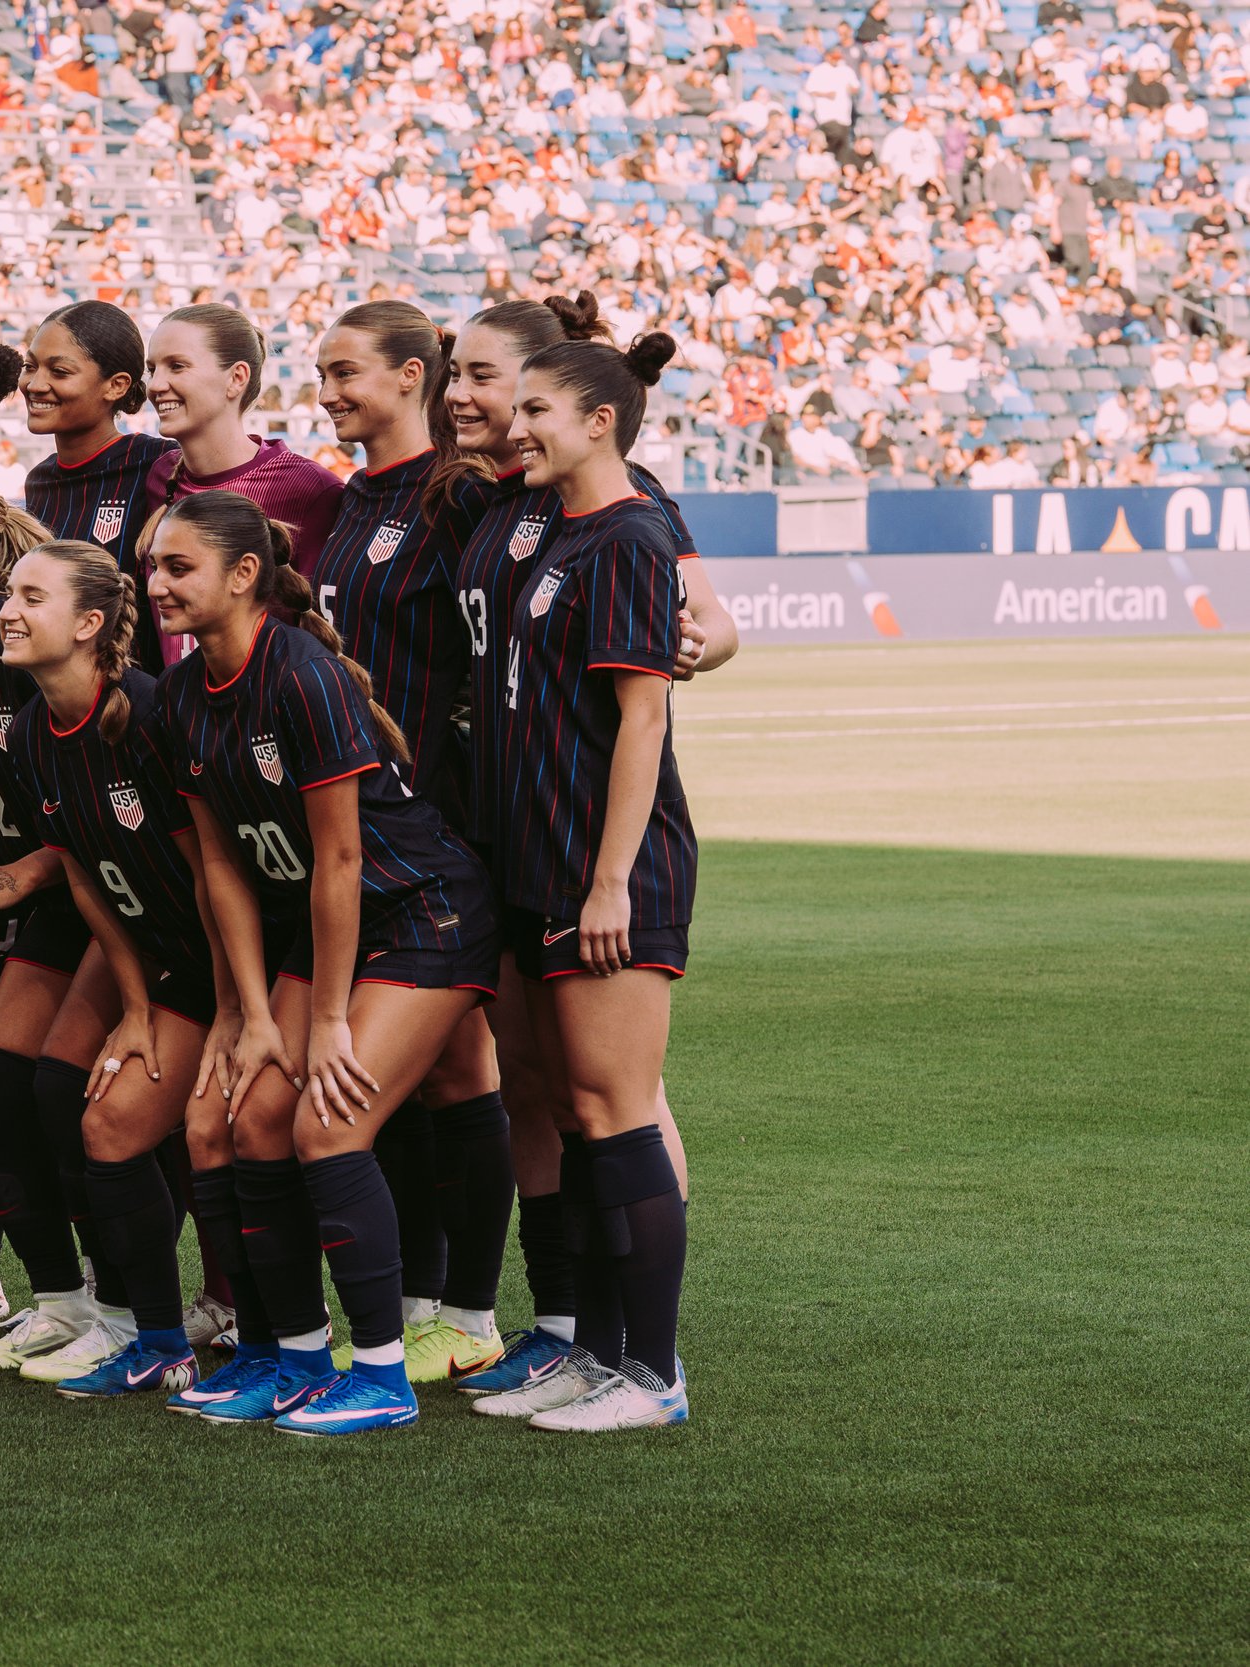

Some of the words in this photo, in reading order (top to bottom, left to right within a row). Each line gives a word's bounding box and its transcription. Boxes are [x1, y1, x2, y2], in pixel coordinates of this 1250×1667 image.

[458, 588, 487, 657] 13
[716, 582, 844, 630] erican
[993, 577, 1167, 625] American
[237, 820, 307, 881] 20
[99, 859, 144, 918] 9
